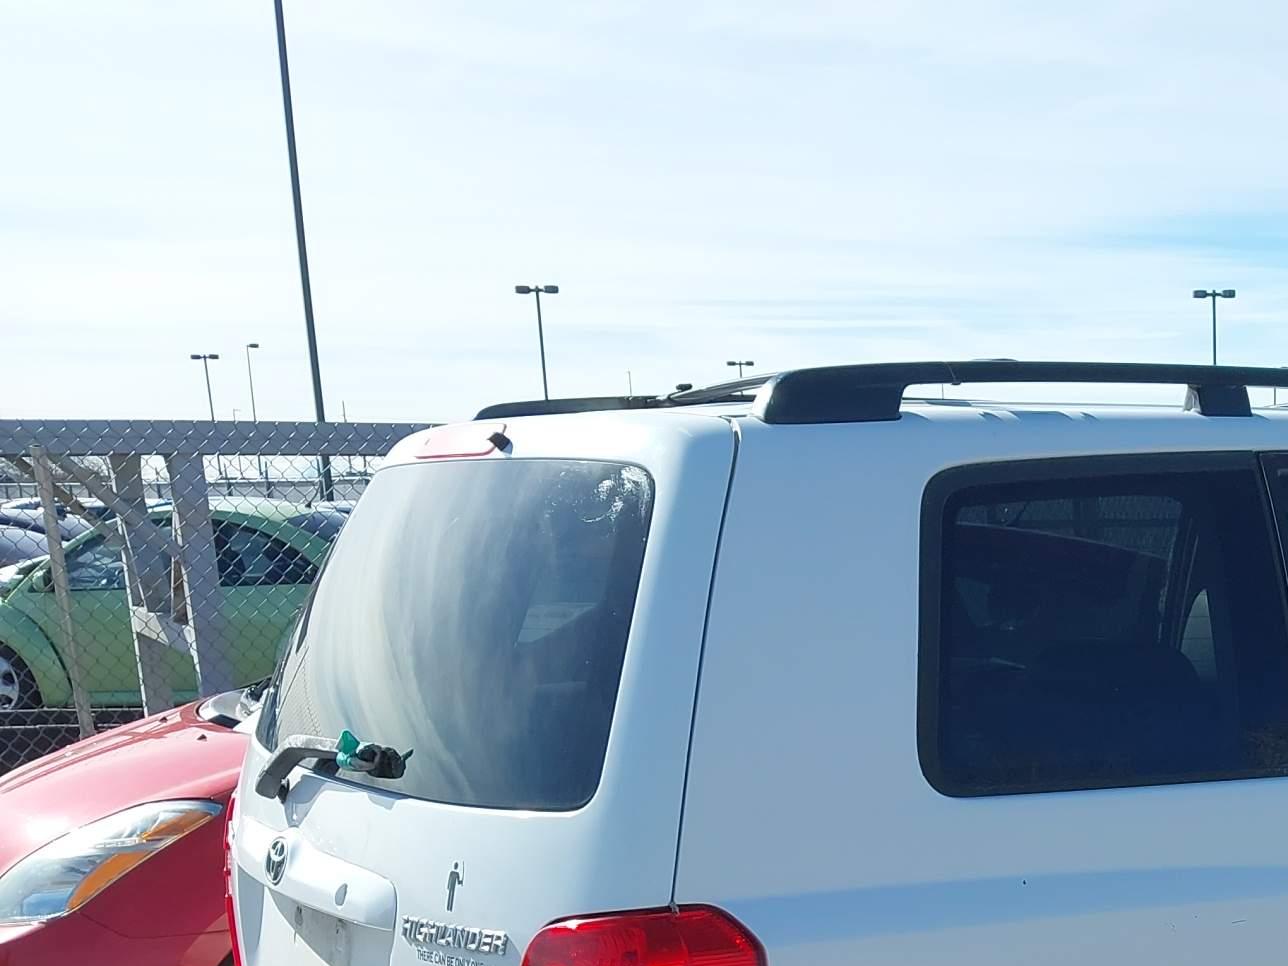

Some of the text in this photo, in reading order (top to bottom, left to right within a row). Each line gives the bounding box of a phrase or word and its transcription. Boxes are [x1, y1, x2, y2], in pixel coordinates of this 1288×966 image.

[401, 915, 508, 955] HIGHLANDER
[417, 948, 433, 963] THERE
[434, 951, 446, 966] CAN
